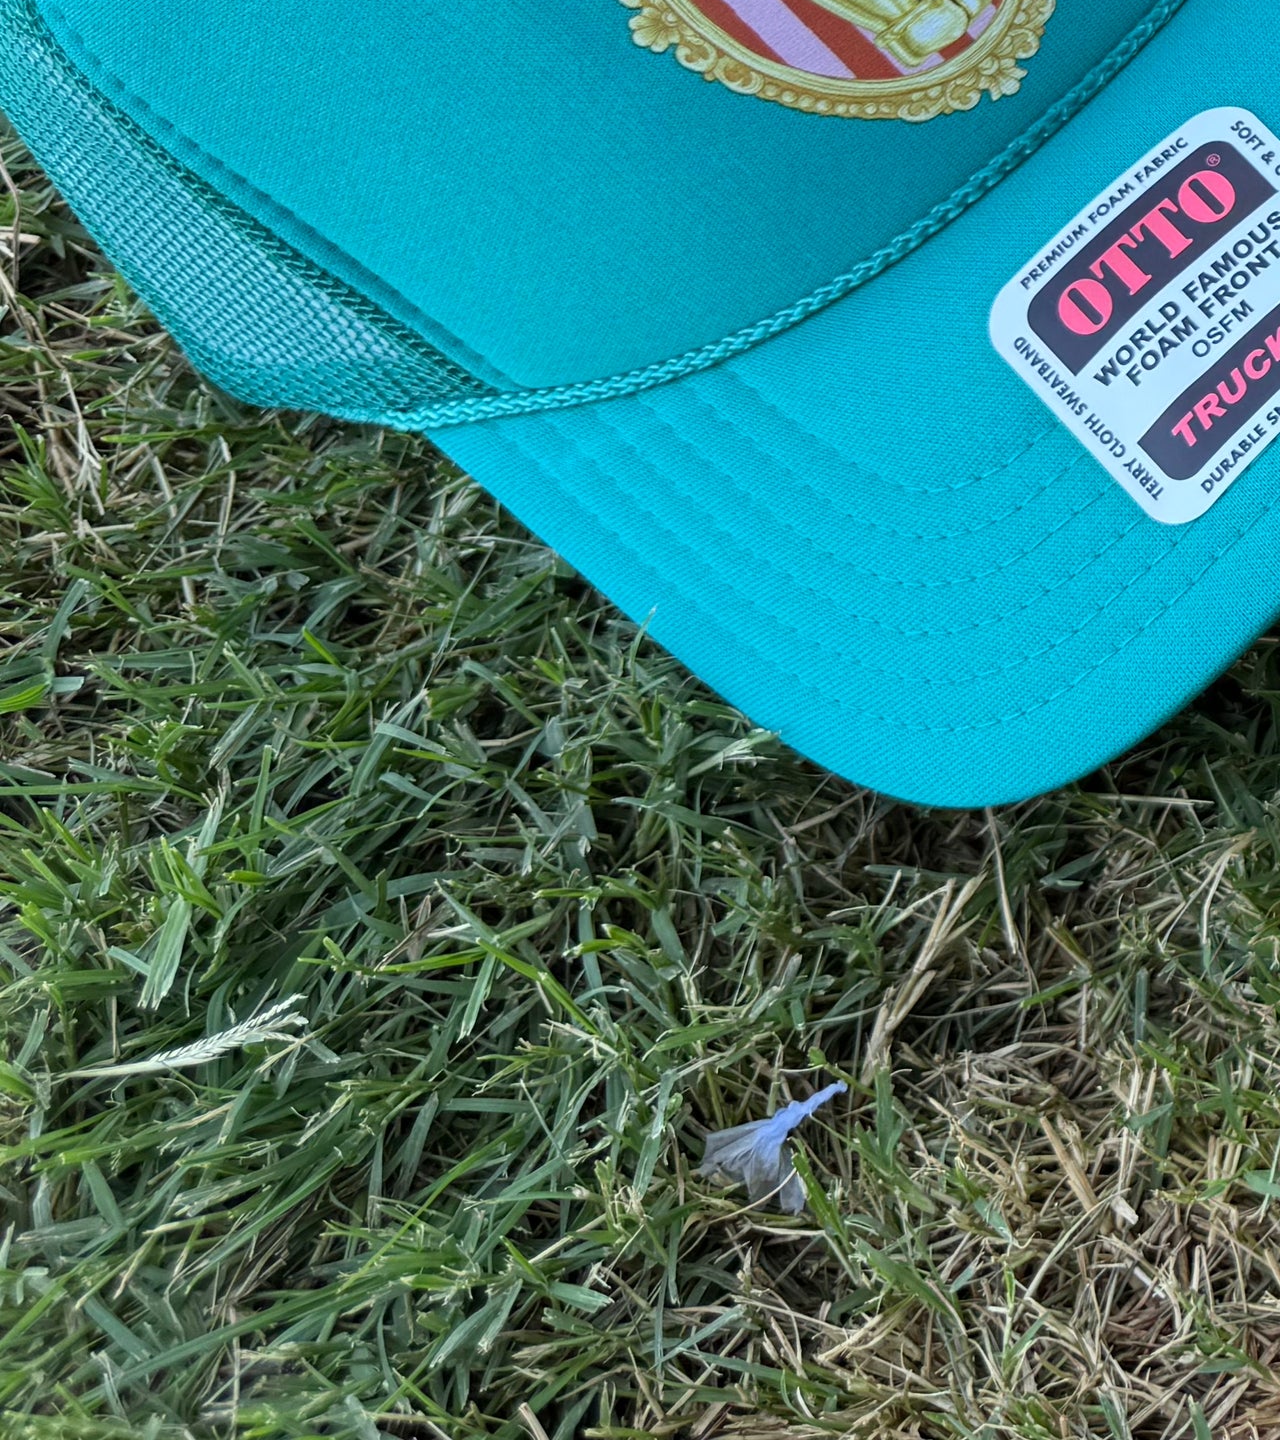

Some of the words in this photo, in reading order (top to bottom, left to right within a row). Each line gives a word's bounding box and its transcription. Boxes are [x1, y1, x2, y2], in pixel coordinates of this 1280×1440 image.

[1231, 120, 1265, 153] SOFT
[1262, 151, 1274, 164] &
[1020, 224, 1089, 290] PREMIUM
[1088, 182, 1134, 225] FOAM
[1136, 137, 1189, 183] FABRIC
[1094, 301, 1180, 387] WORLD
[1125, 316, 1199, 387] FOAM
[1192, 300, 1254, 358] OSFM
[1014, 337, 1087, 416] SWEATBAND
[1084, 415, 1127, 458] CLOTH
[1201, 427, 1267, 493] DURABLE
[1123, 461, 1164, 501] TERRY
